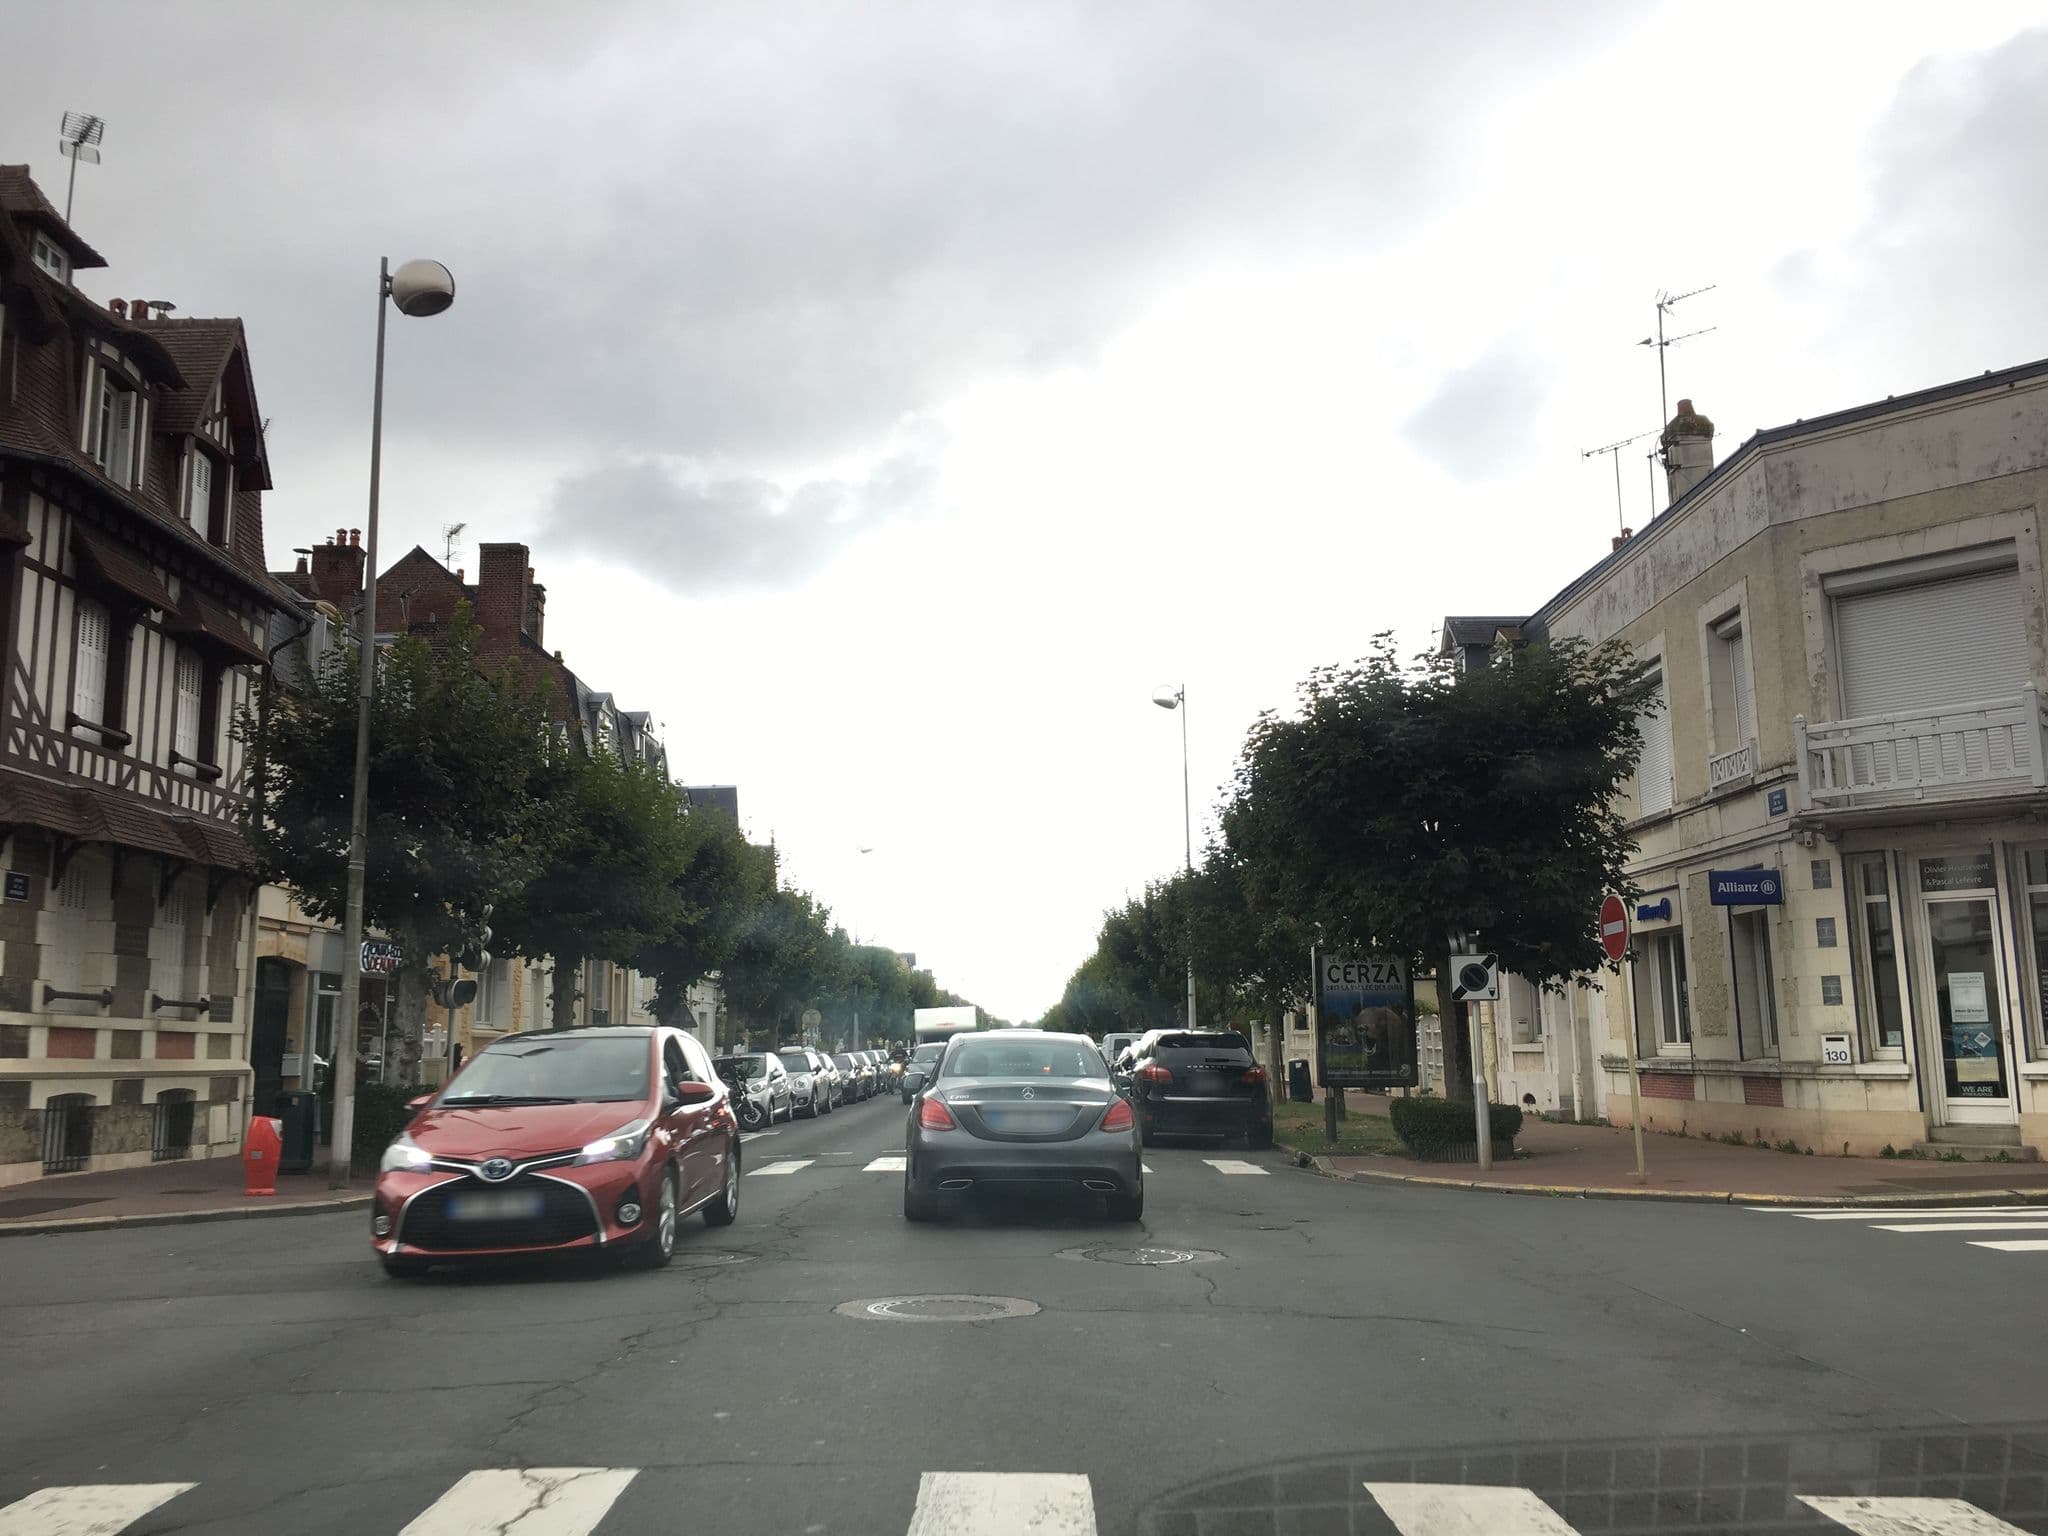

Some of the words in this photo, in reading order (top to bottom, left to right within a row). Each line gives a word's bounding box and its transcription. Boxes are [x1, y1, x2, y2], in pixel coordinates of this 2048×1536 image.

[1718, 881, 1759, 893] Allianz
[1327, 963, 1401, 983] CERZA
[1825, 1050, 1848, 1061] 130
[1977, 1085, 1993, 1093] ARE
